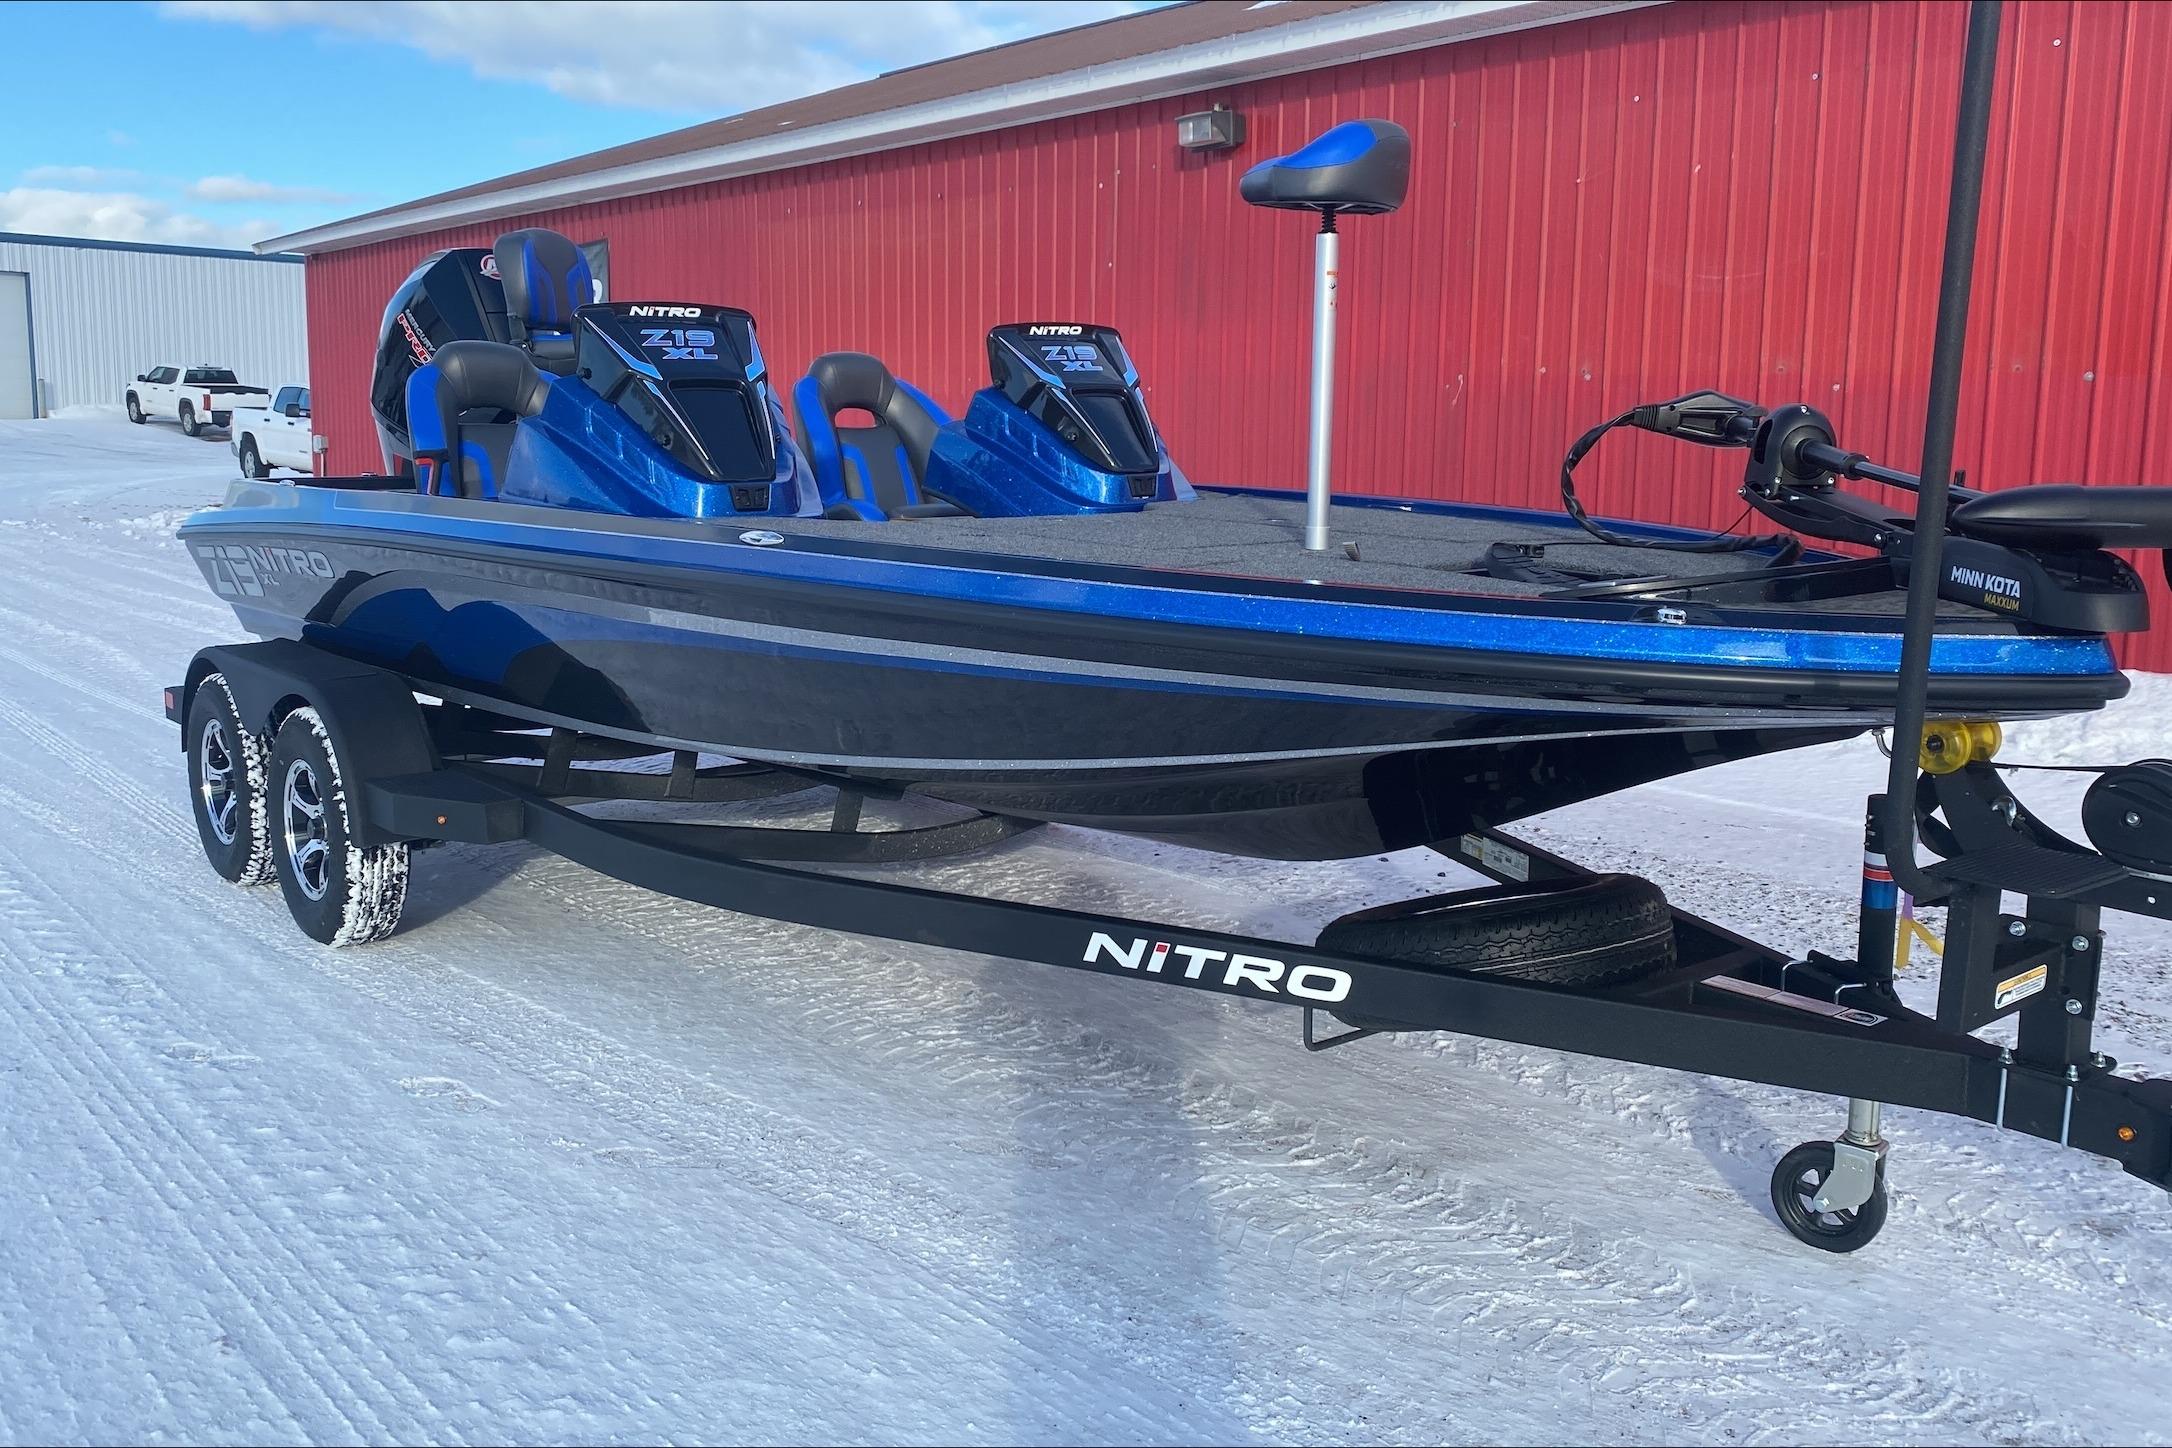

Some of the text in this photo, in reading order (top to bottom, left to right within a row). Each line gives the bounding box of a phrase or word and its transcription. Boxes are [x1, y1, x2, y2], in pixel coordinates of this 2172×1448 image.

[404, 308, 437, 352] MERCURY
[640, 328, 716, 347] Z19
[662, 347, 719, 360] XL
[1040, 345, 1098, 361] Z19
[1061, 360, 1104, 372] XL
[260, 572, 281, 586] XL
[1950, 565, 2021, 599] MINN KOTA
[1983, 592, 2020, 612] MAXXUM
